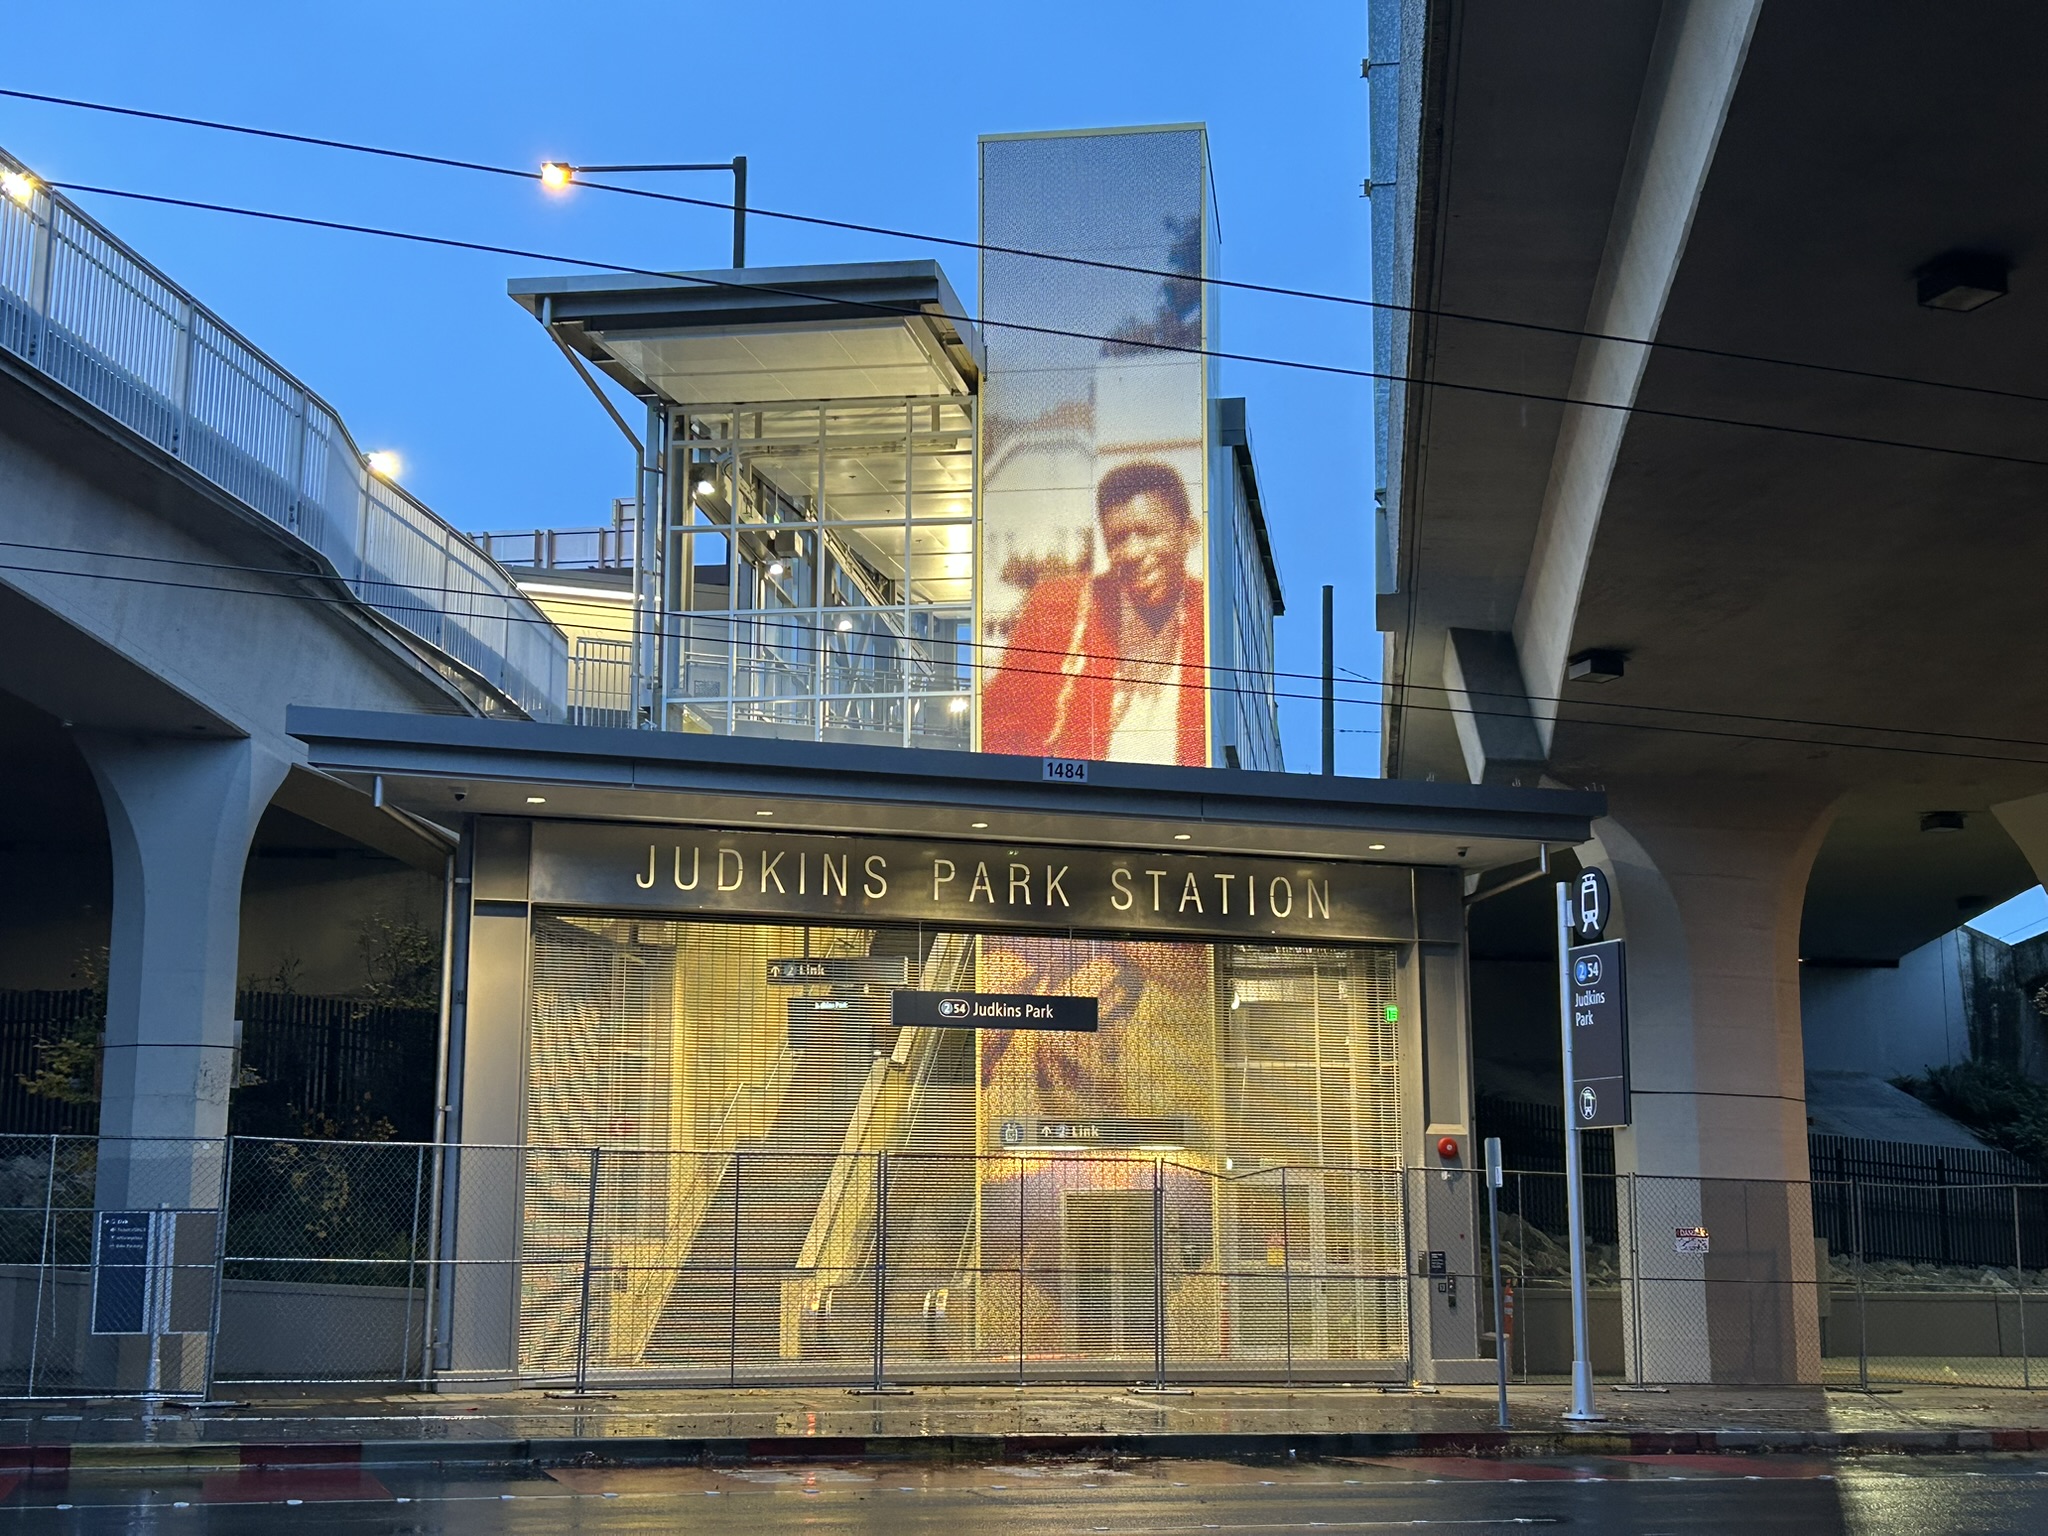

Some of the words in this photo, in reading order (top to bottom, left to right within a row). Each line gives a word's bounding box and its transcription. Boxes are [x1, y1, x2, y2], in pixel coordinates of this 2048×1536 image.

[1047, 762, 1085, 779] 1484
[635, 845, 888, 899] JUDKINS
[933, 859, 1070, 907] PARK
[1111, 868, 1330, 919] STATION
[799, 964, 825, 976] Link
[1575, 990, 1605, 1007] Judkins
[973, 1002, 1021, 1017] Judkins
[1025, 1004, 1054, 1018] Park
[1576, 1010, 1594, 1026] Park
[1072, 1124, 1099, 1137] Link
